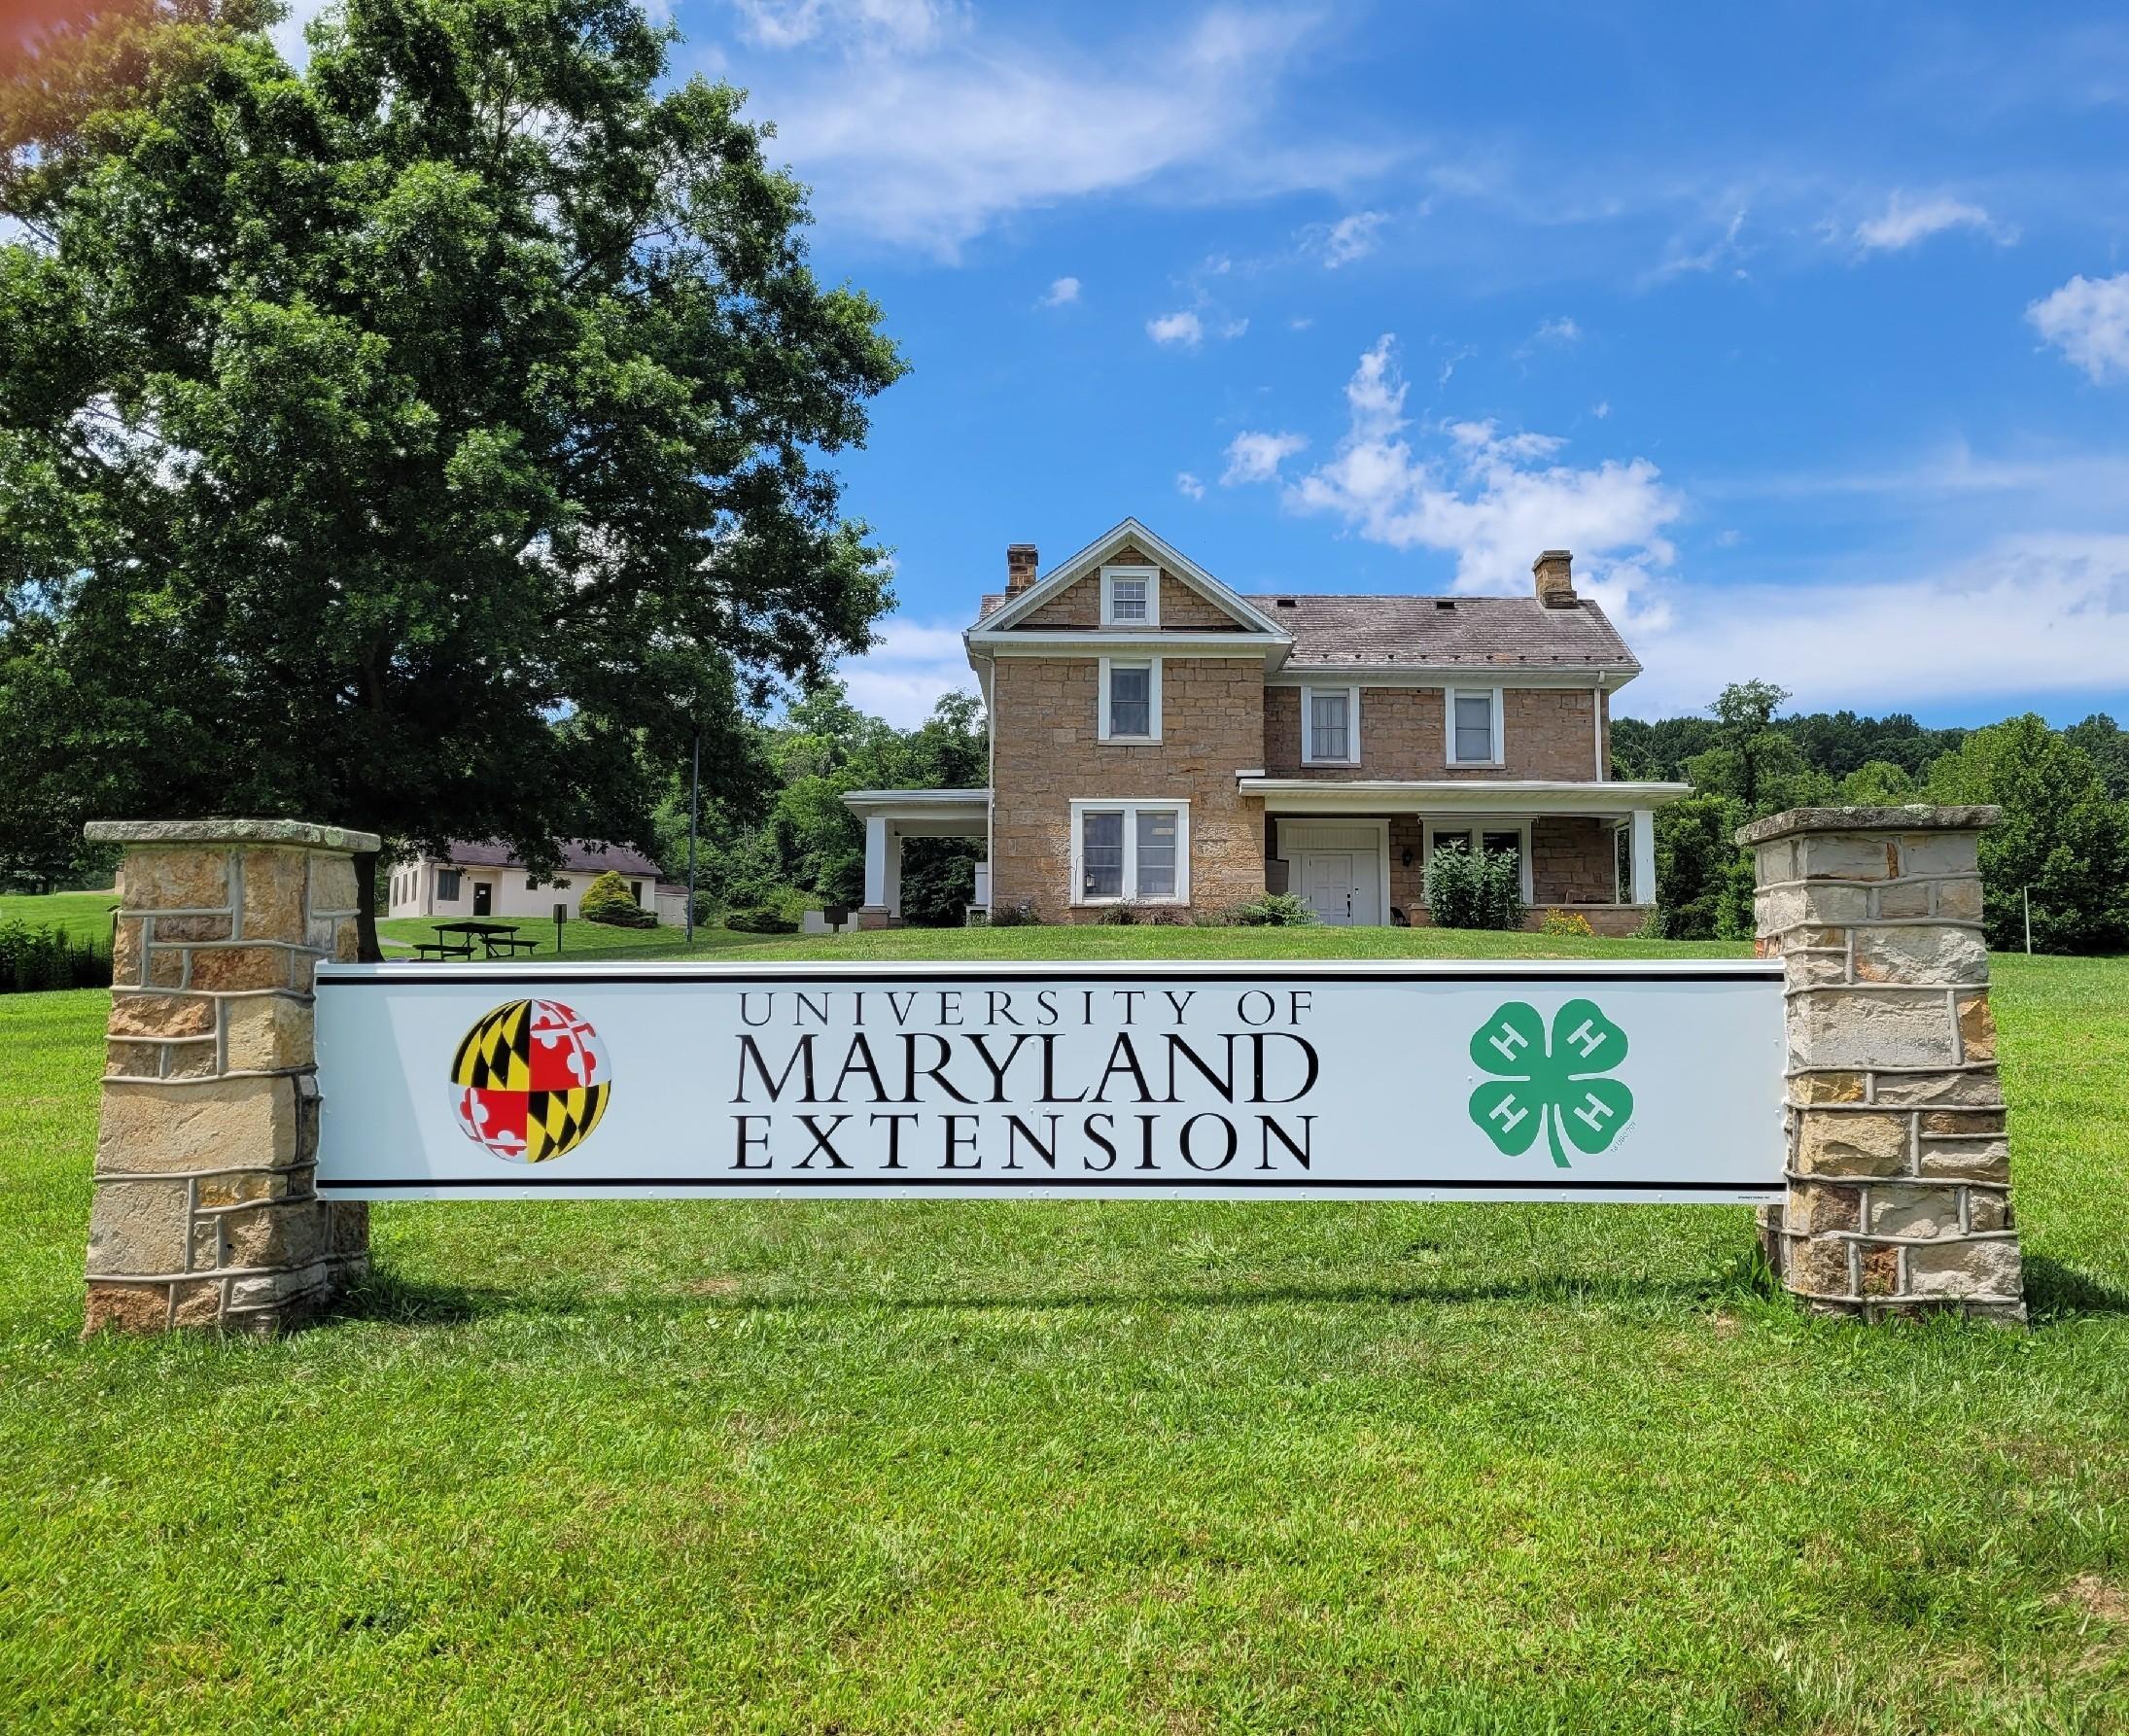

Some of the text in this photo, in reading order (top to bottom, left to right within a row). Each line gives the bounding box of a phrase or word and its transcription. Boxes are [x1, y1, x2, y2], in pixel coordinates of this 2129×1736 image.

[737, 990, 1312, 1026] UNIVERSITY OF
[1489, 1022, 1528, 1061] H
[1566, 1019, 1607, 1059] H
[728, 1031, 1319, 1105] MARYLAND
[1488, 1093, 1529, 1134] H
[1573, 1092, 1615, 1132] H
[728, 1112, 1319, 1172] EXTENSION
